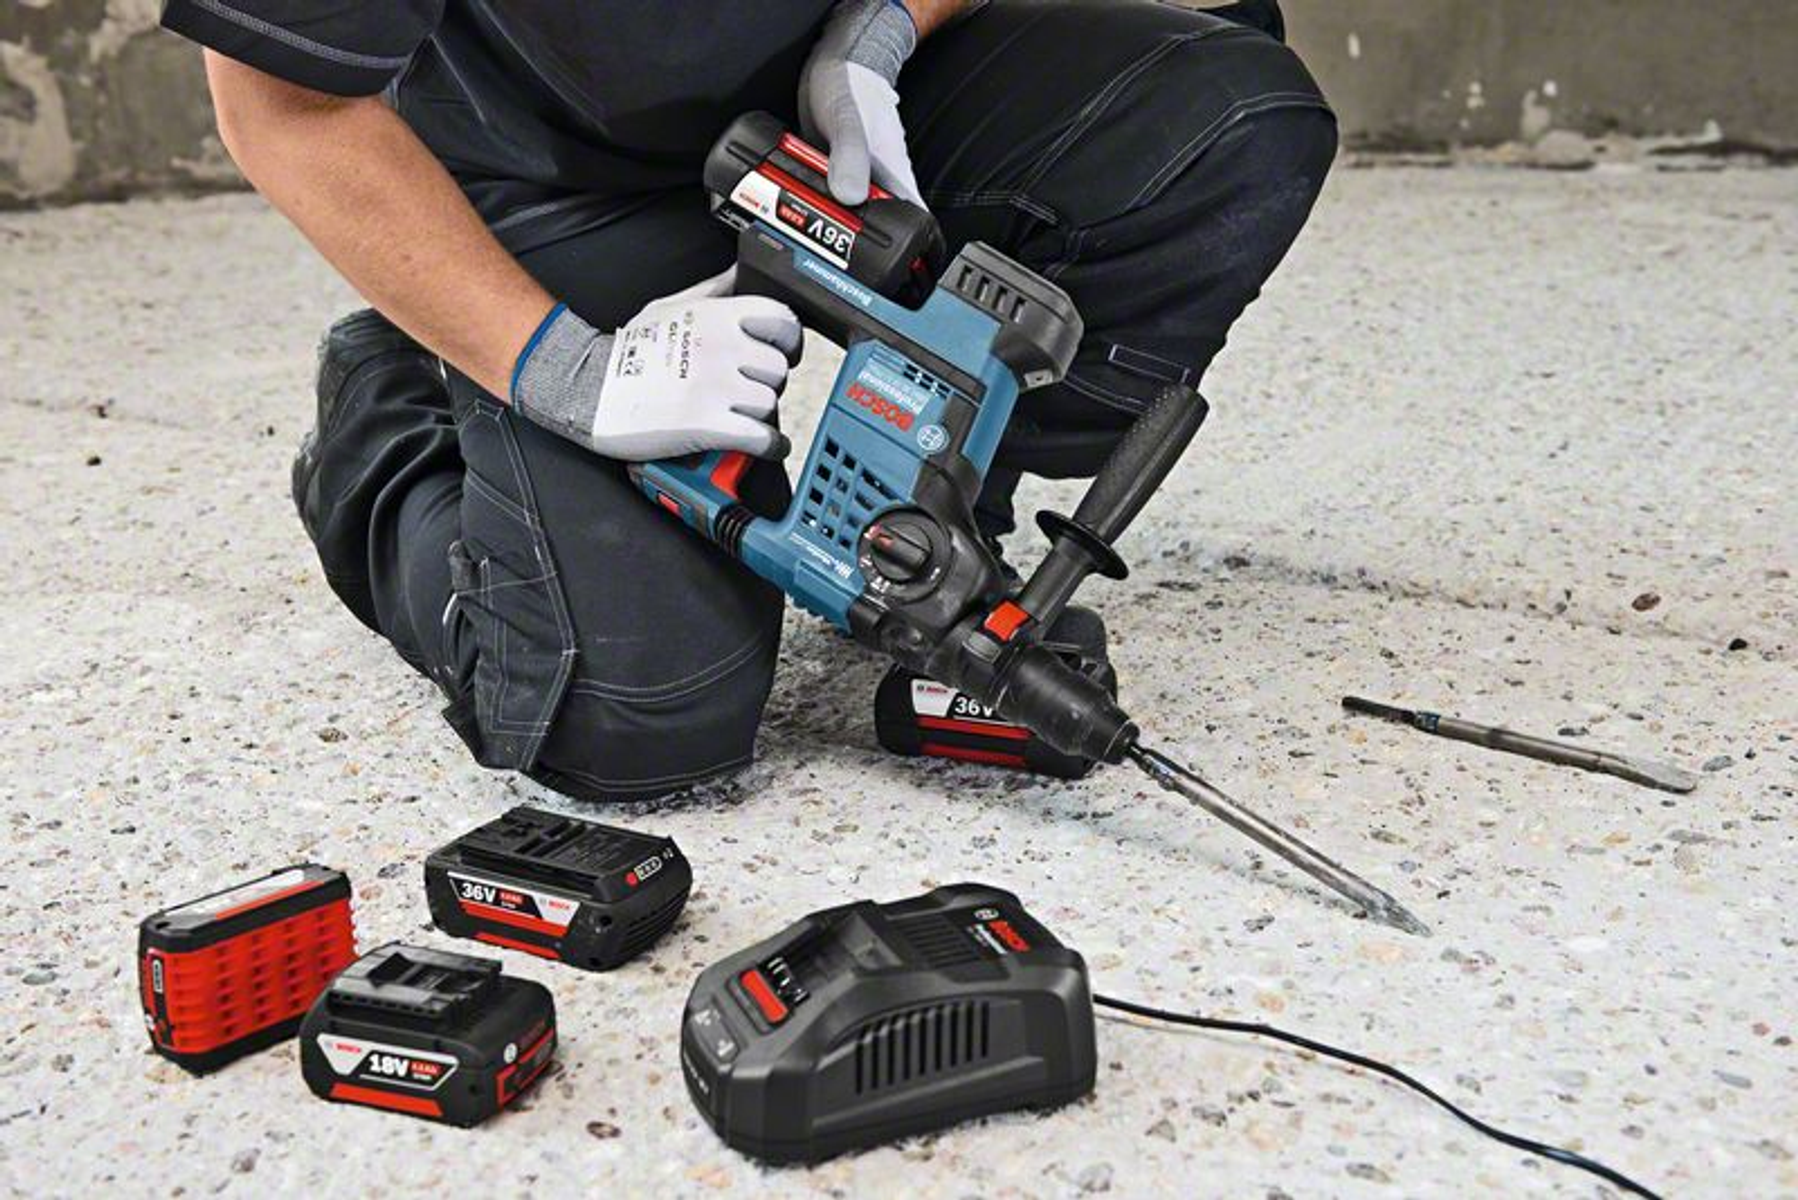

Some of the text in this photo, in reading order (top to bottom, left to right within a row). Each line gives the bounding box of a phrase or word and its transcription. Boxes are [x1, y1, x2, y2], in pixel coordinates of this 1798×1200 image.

[807, 218, 851, 252] 36V
[845, 382, 915, 433] BOSCH
[857, 372, 923, 415] Professional
[461, 882, 496, 903] 36V
[369, 1053, 409, 1077] 18V
